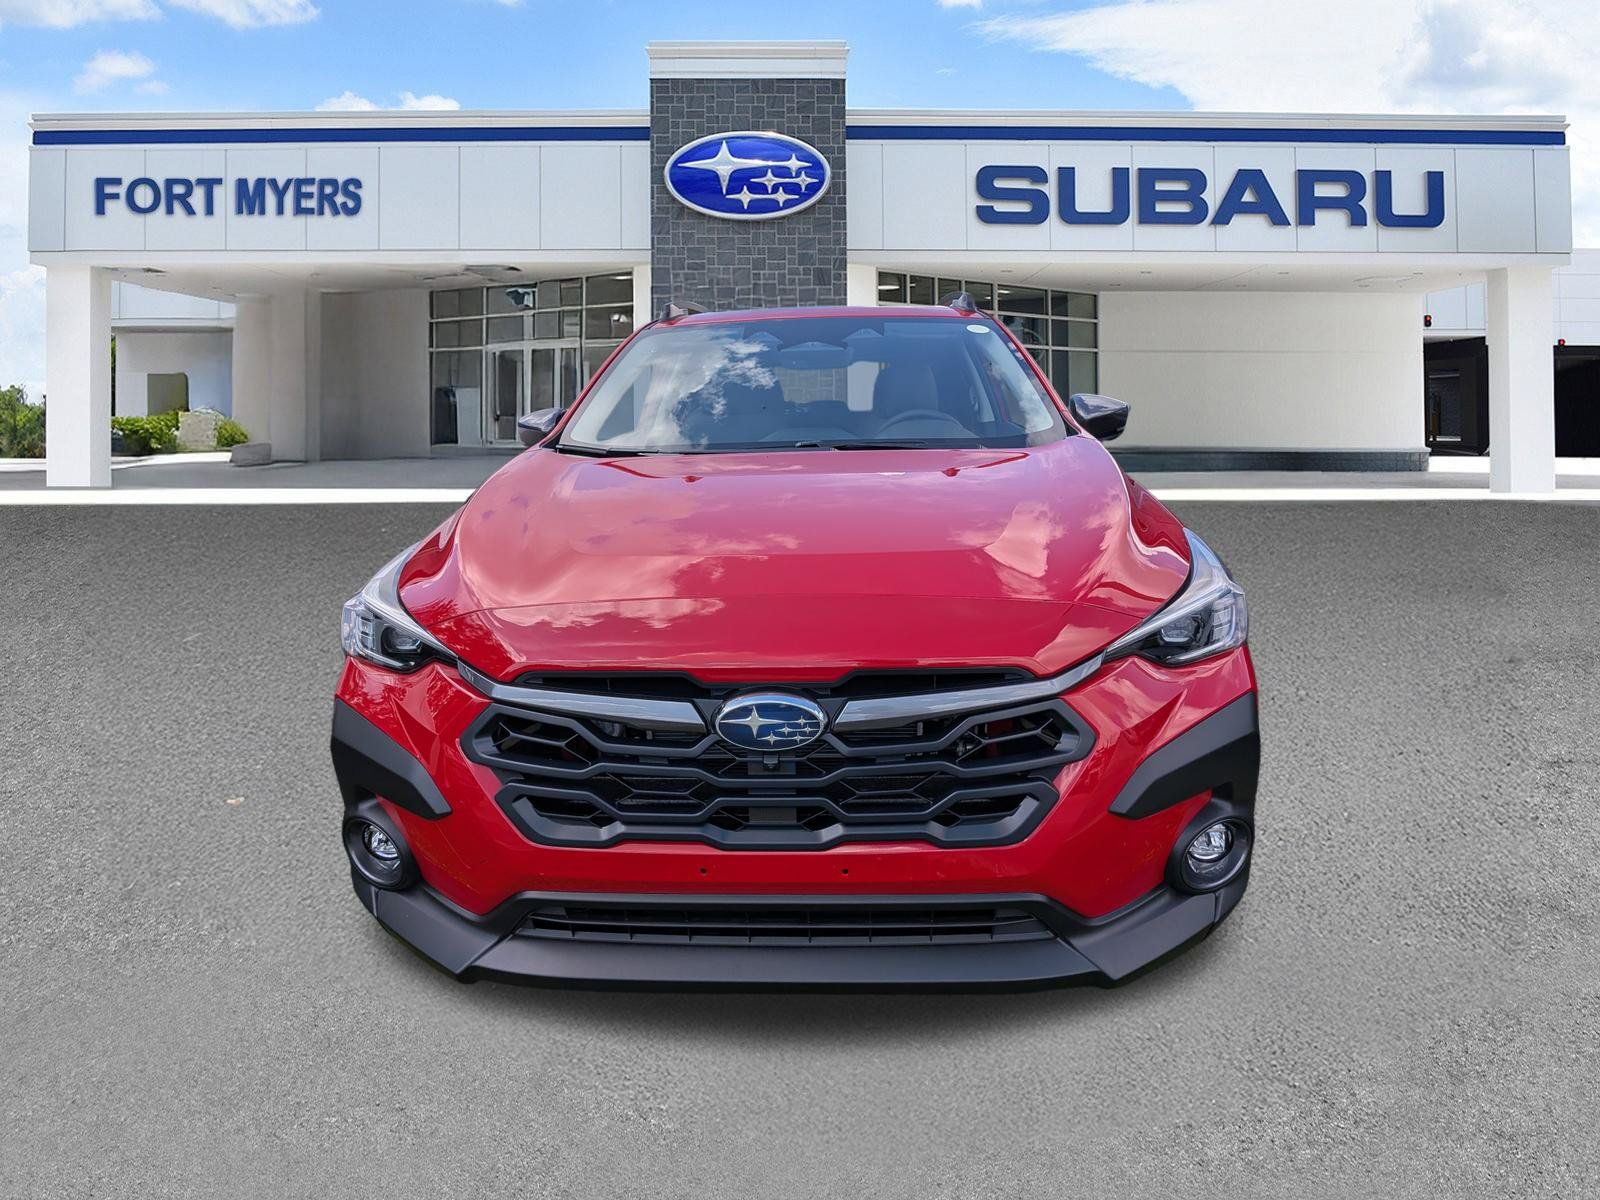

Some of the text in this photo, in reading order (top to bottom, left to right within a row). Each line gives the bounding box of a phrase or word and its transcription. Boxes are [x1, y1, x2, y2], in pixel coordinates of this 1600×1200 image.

[95, 177, 363, 217] FORT MYERS
[976, 165, 1445, 229] SUBARU
